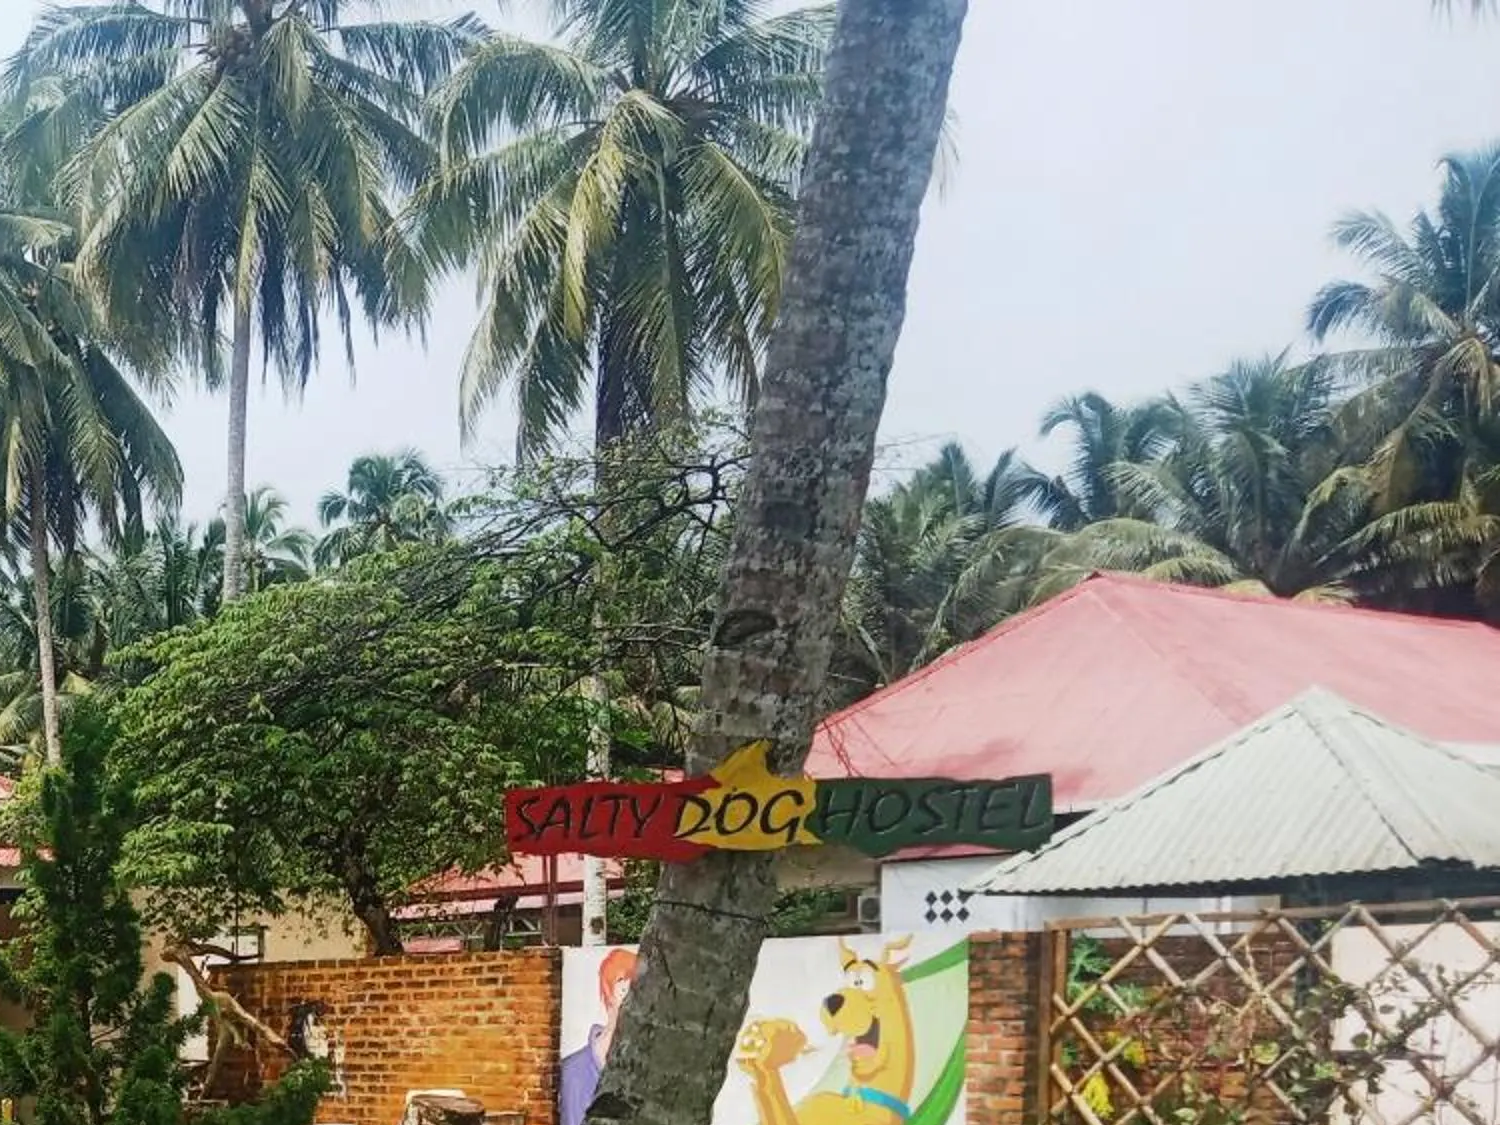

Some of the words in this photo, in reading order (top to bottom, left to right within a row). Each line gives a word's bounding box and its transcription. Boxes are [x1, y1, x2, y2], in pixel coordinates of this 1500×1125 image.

[513, 794, 665, 842] SALTY
[674, 789, 804, 843] DOG
[820, 784, 1048, 835] HOSTEL
